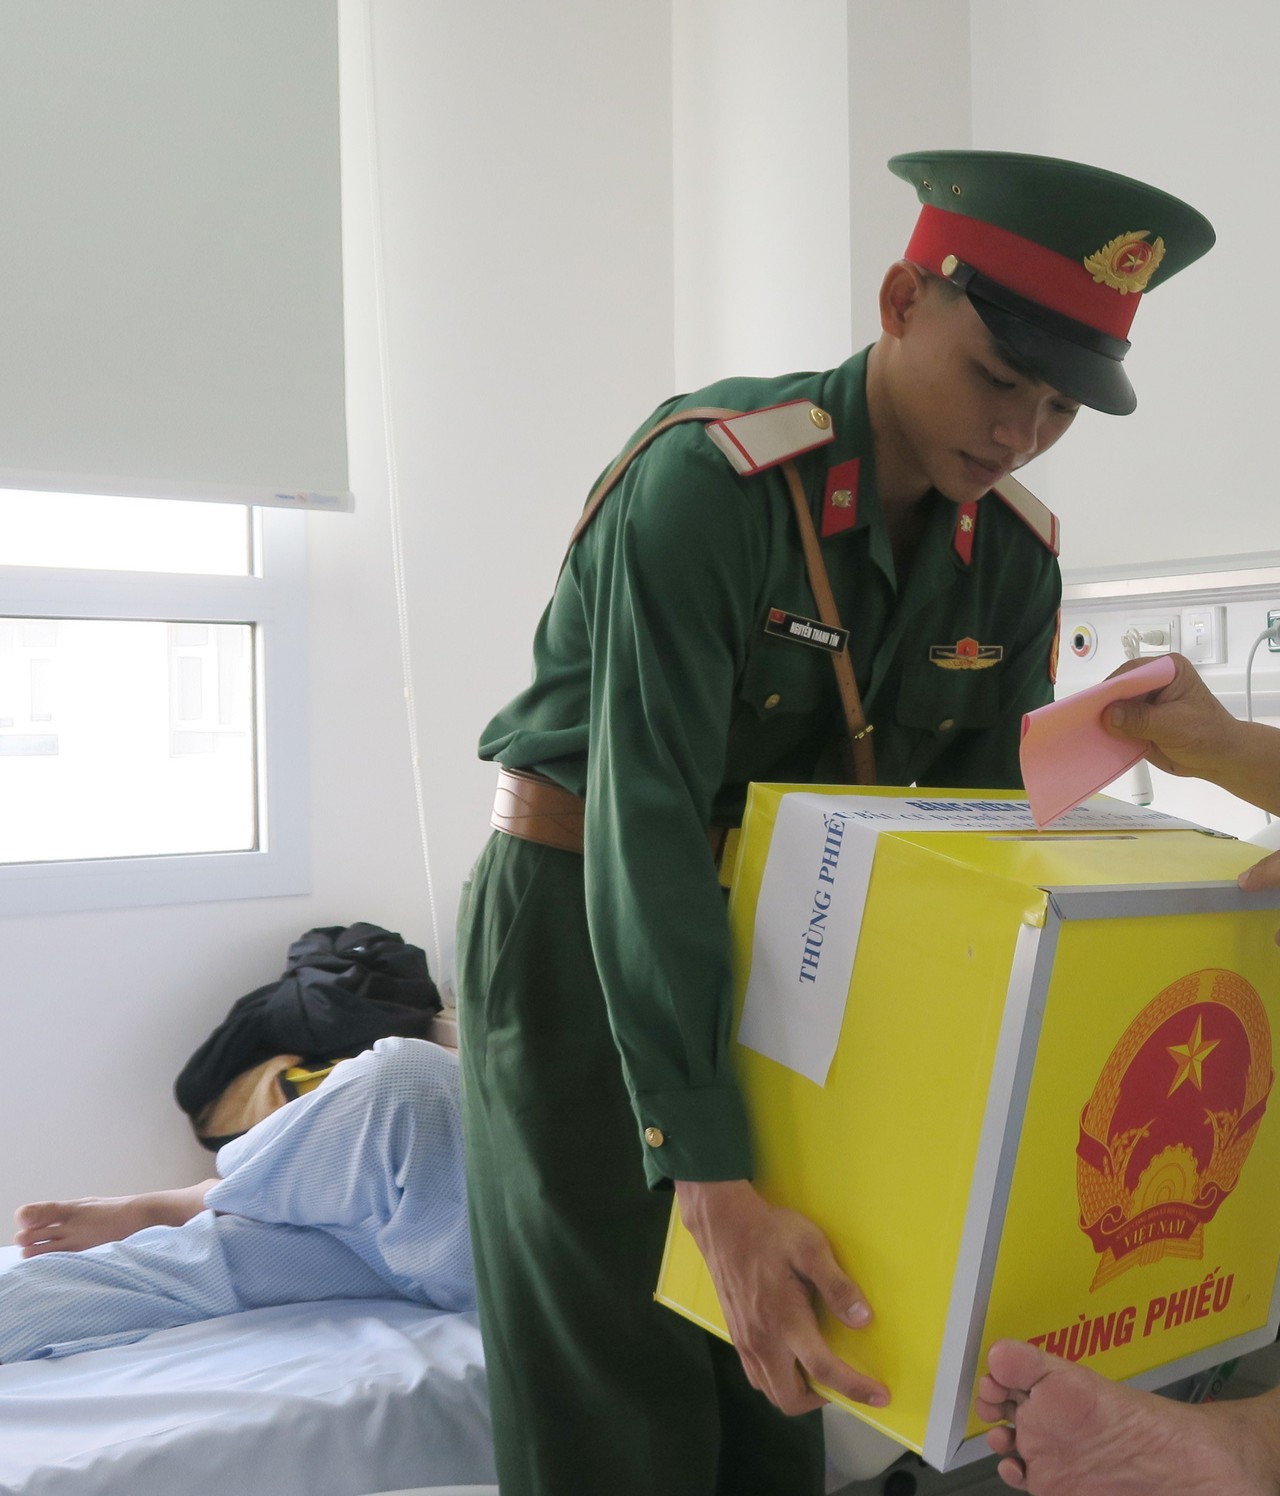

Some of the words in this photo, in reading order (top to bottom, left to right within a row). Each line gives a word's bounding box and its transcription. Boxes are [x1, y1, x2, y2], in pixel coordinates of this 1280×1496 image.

[799, 890, 832, 984] THÙNG
[819, 811, 855, 885] PHIẾU
[1143, 1266, 1235, 1337] PHIẾU
